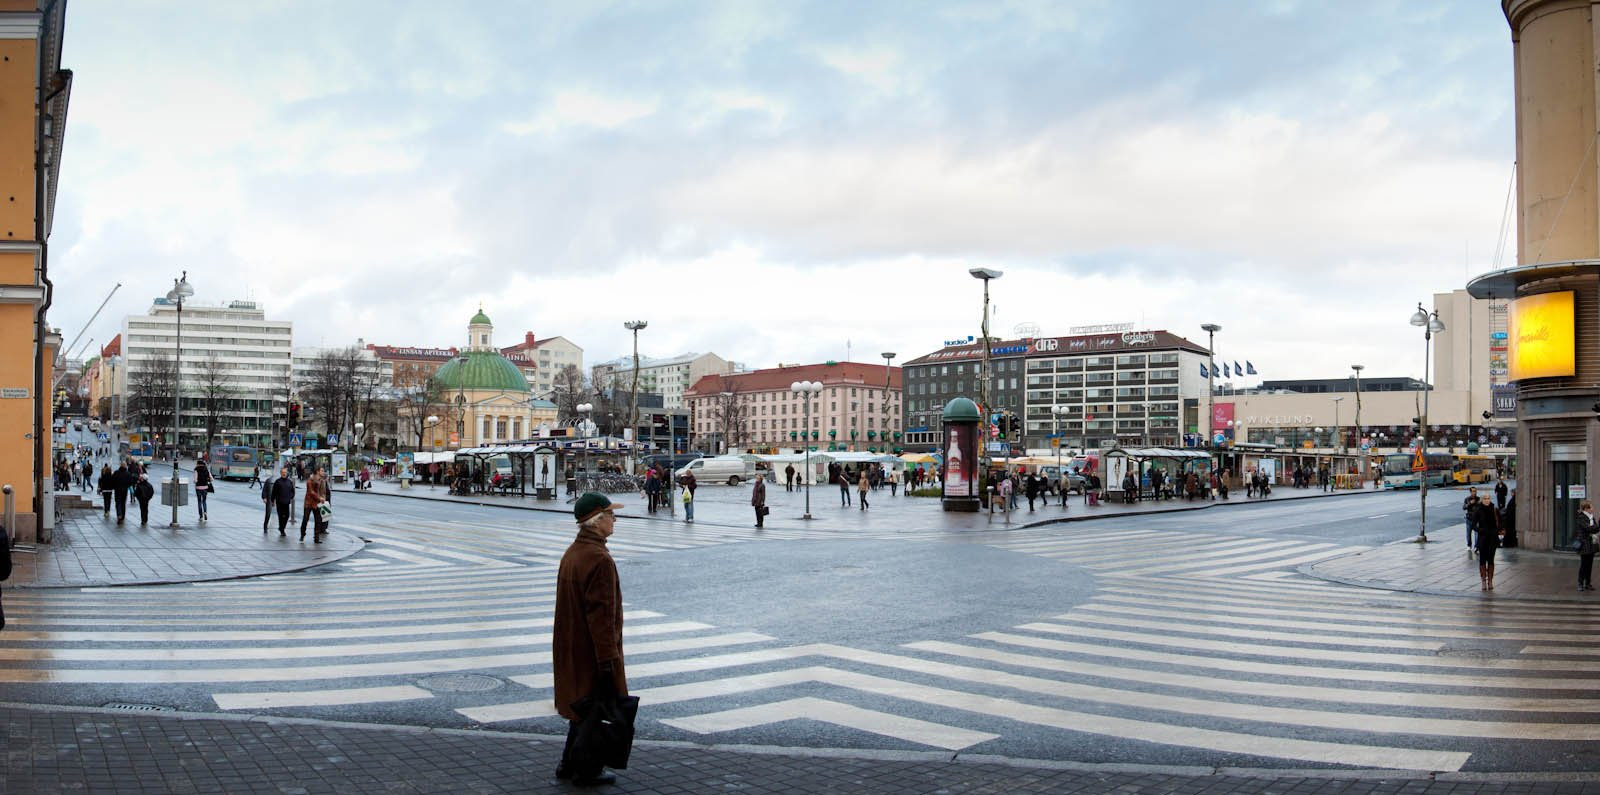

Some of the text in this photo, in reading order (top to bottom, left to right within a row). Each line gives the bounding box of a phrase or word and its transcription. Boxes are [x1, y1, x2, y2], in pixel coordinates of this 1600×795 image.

[1121, 330, 1154, 344] Carlsberg
[1035, 338, 1058, 352] dna
[1496, 398, 1516, 409] SOKOS
[1246, 415, 1312, 424] WIKLUND
